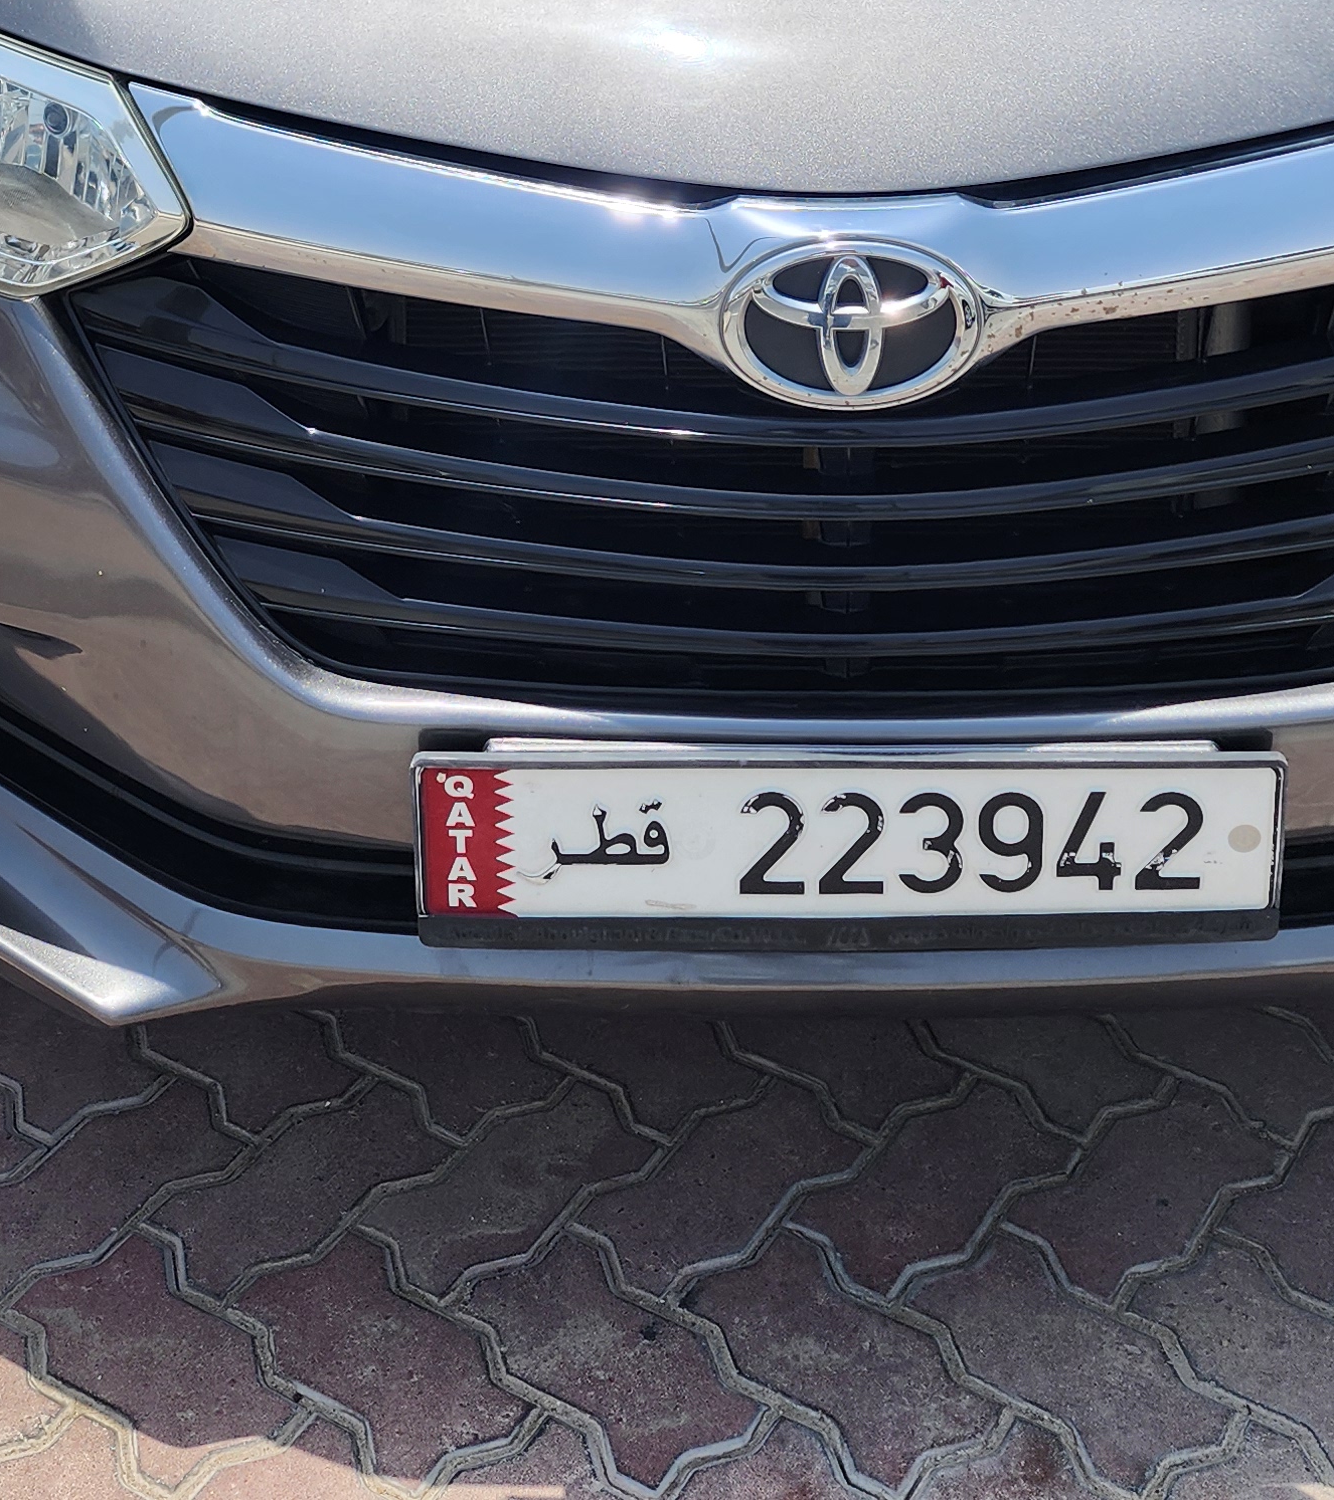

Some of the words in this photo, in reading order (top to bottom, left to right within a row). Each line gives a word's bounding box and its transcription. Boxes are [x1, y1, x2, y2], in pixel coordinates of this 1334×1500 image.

[443, 775, 477, 908] QATAR
[517, 798, 670, 886] قطر
[738, 790, 1205, 894] 223942
